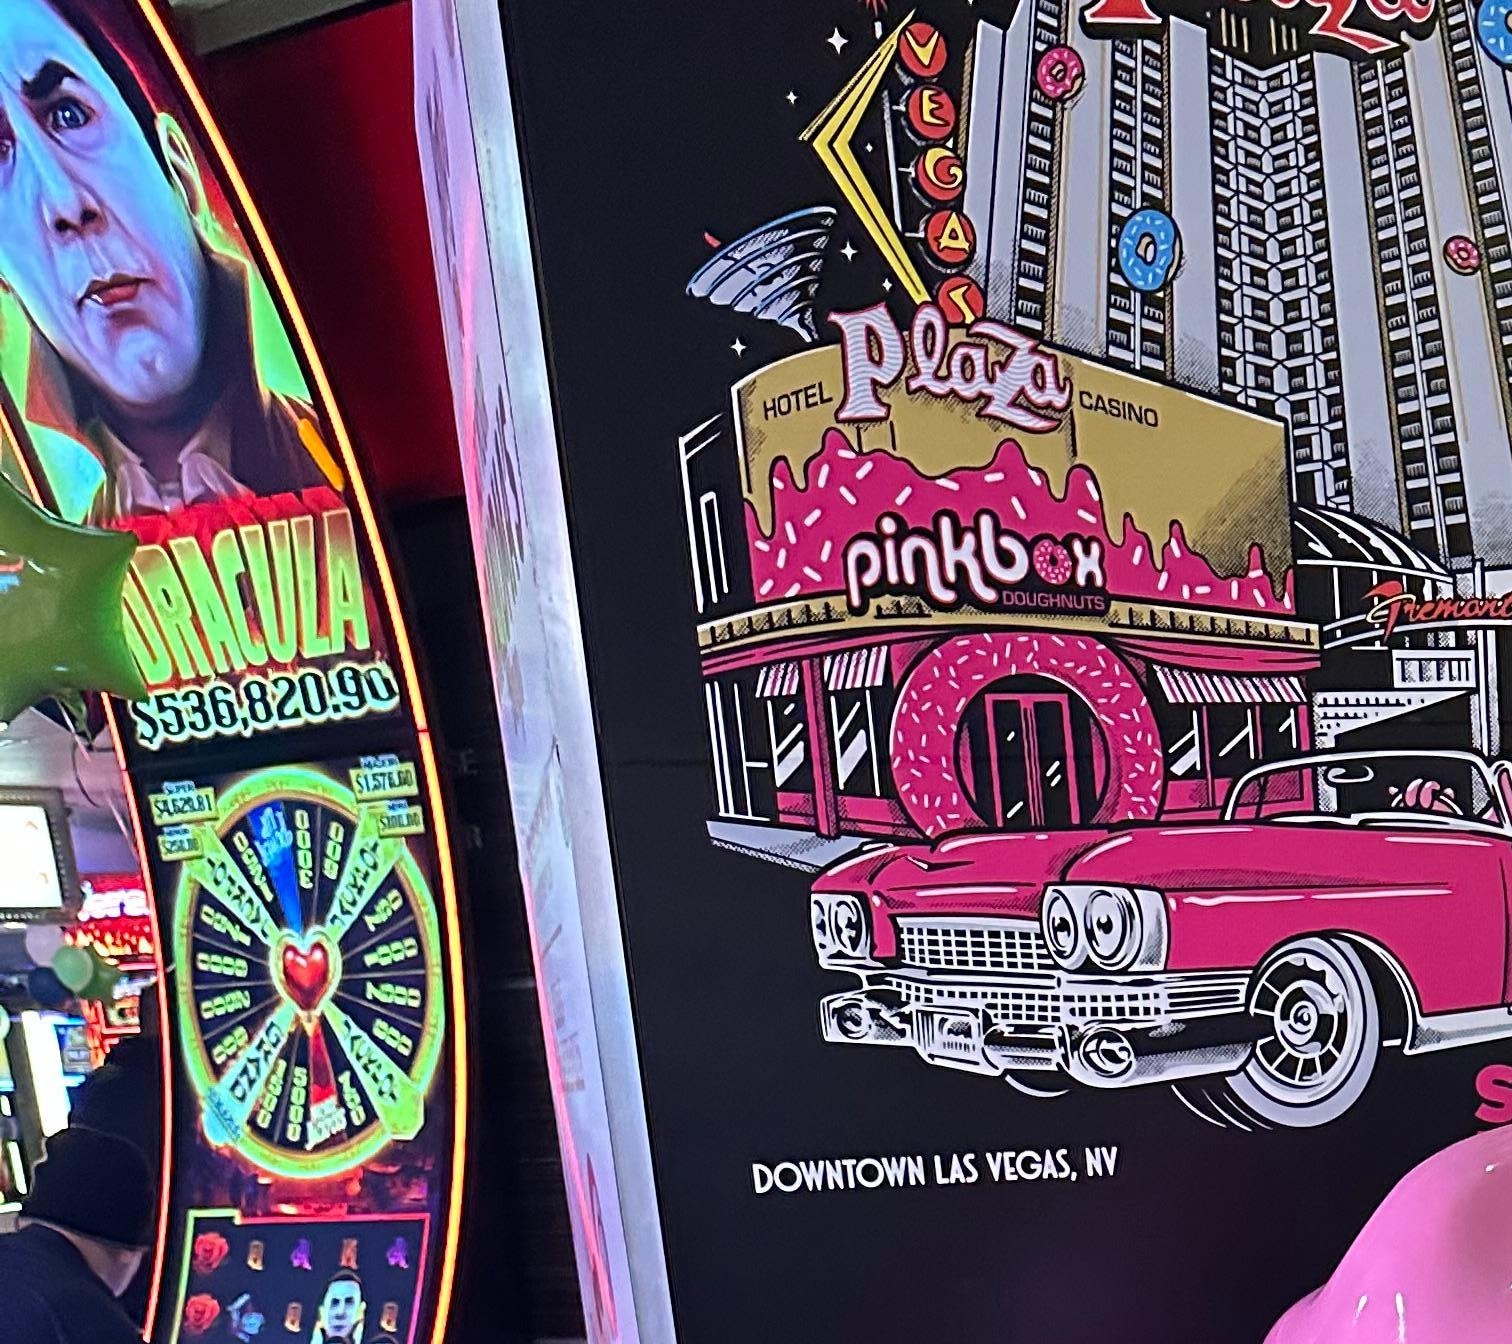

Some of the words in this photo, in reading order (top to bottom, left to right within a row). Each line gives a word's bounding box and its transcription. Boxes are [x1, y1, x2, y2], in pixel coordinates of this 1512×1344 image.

[906, 30, 976, 324] VEGAS
[763, 381, 834, 421] HOTEL
[829, 302, 1073, 433] Plaza
[1078, 390, 1160, 428] CASINO
[846, 513, 1104, 607] pinkbox
[122, 505, 371, 686] DRACULA
[1003, 589, 1105, 611] DOUGHNUTS
[752, 1156, 926, 1194] DOWNTOWN
[934, 1153, 979, 1185] LAS
[986, 1149, 1078, 1182] VEGAS,
[1085, 1147, 1118, 1177] NV
